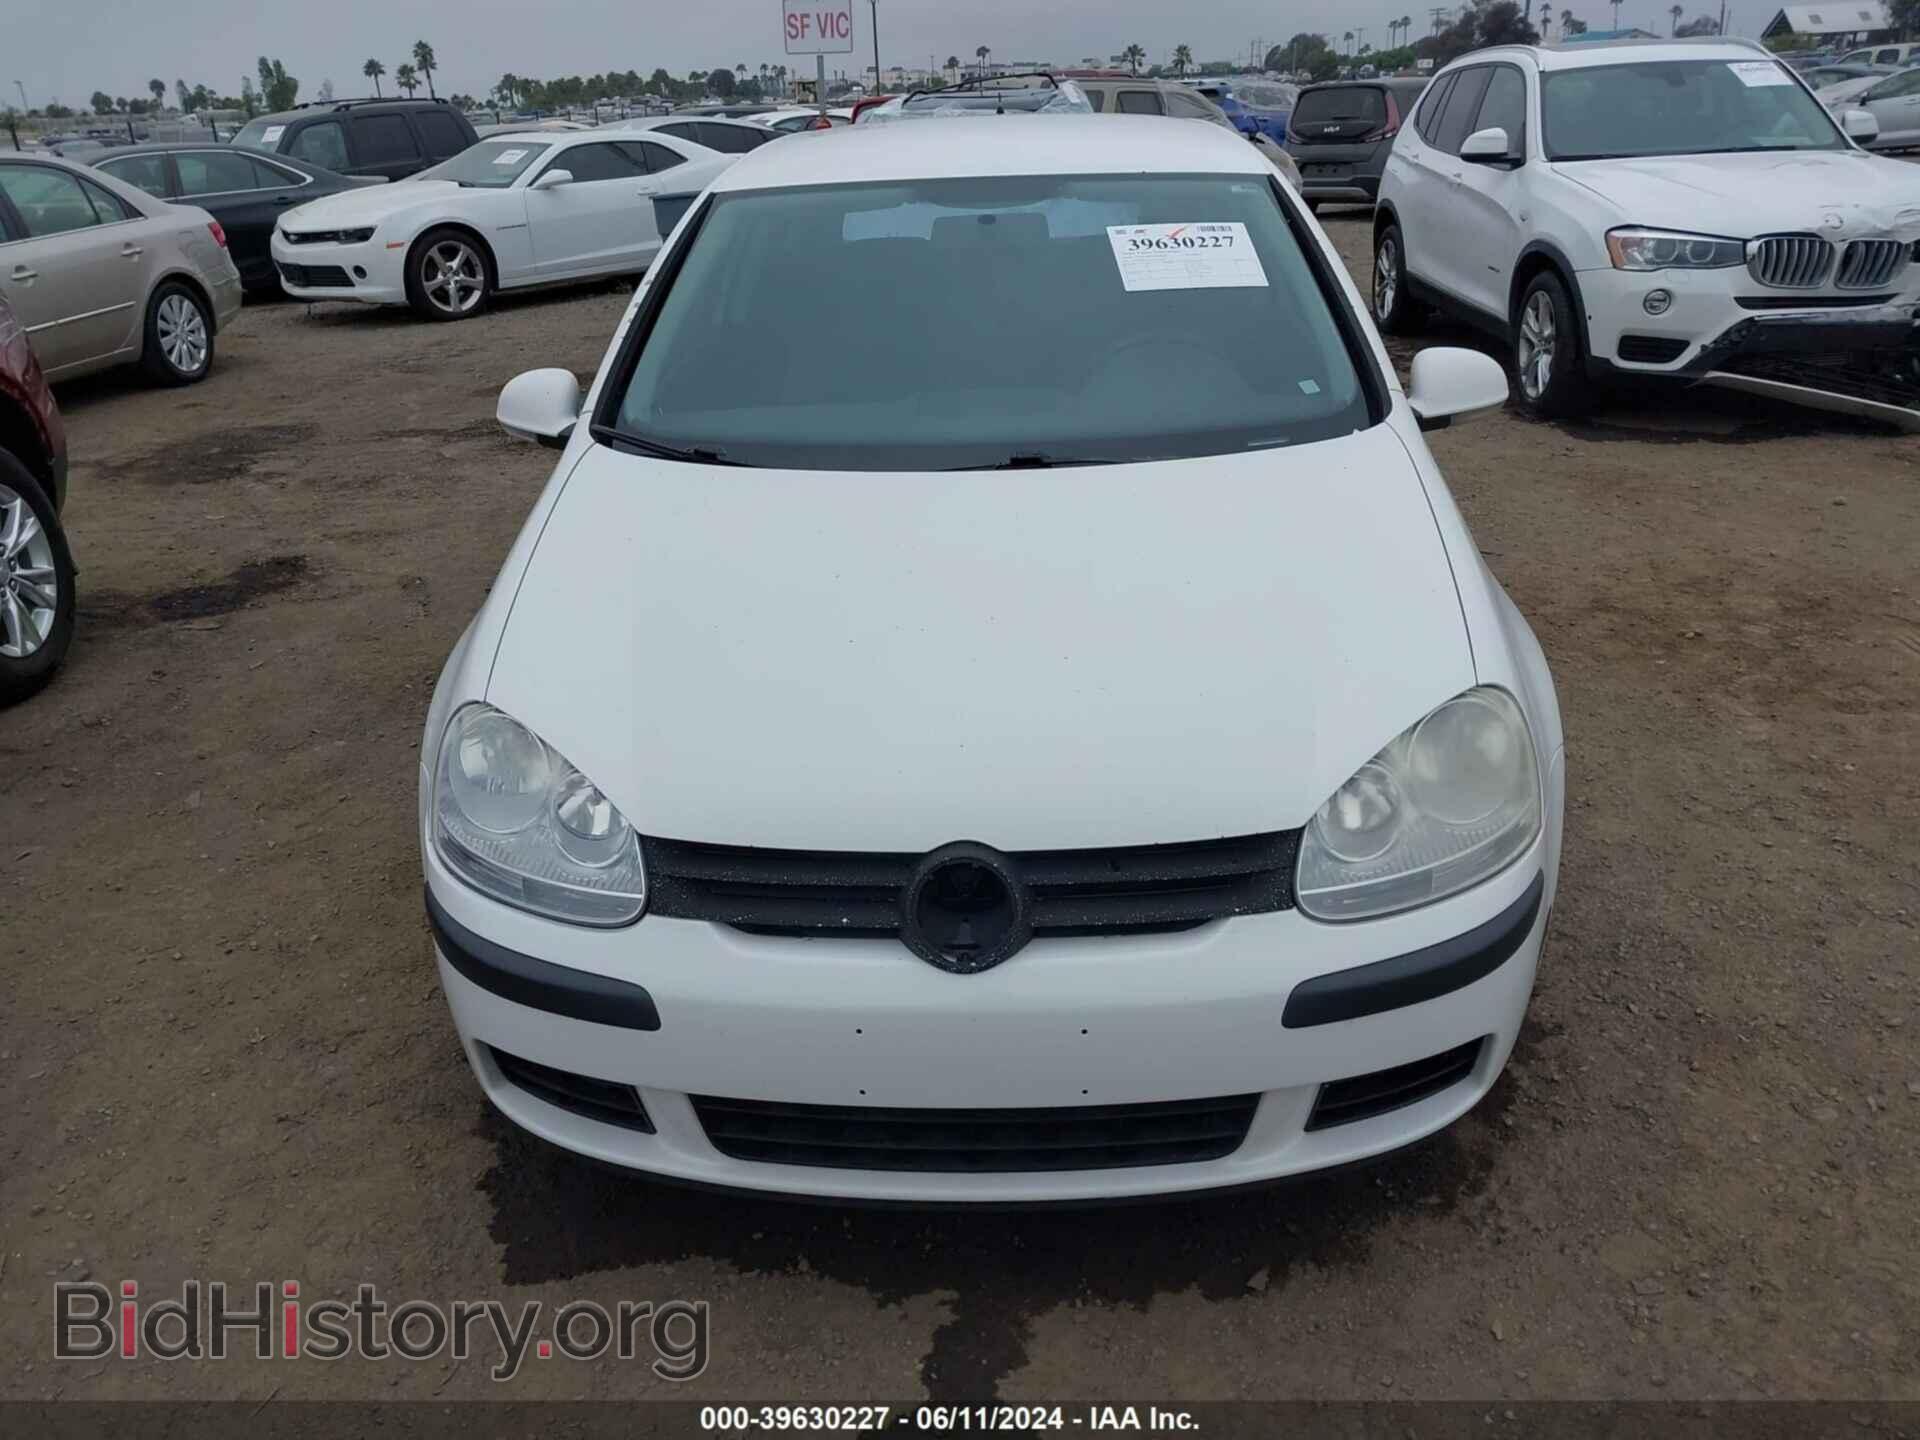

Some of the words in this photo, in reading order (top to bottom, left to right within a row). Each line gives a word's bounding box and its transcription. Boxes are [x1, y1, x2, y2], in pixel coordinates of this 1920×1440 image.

[787, 13, 810, 39] SF
[816, 12, 849, 39] VIC
[1128, 236, 1234, 251] 39630227
